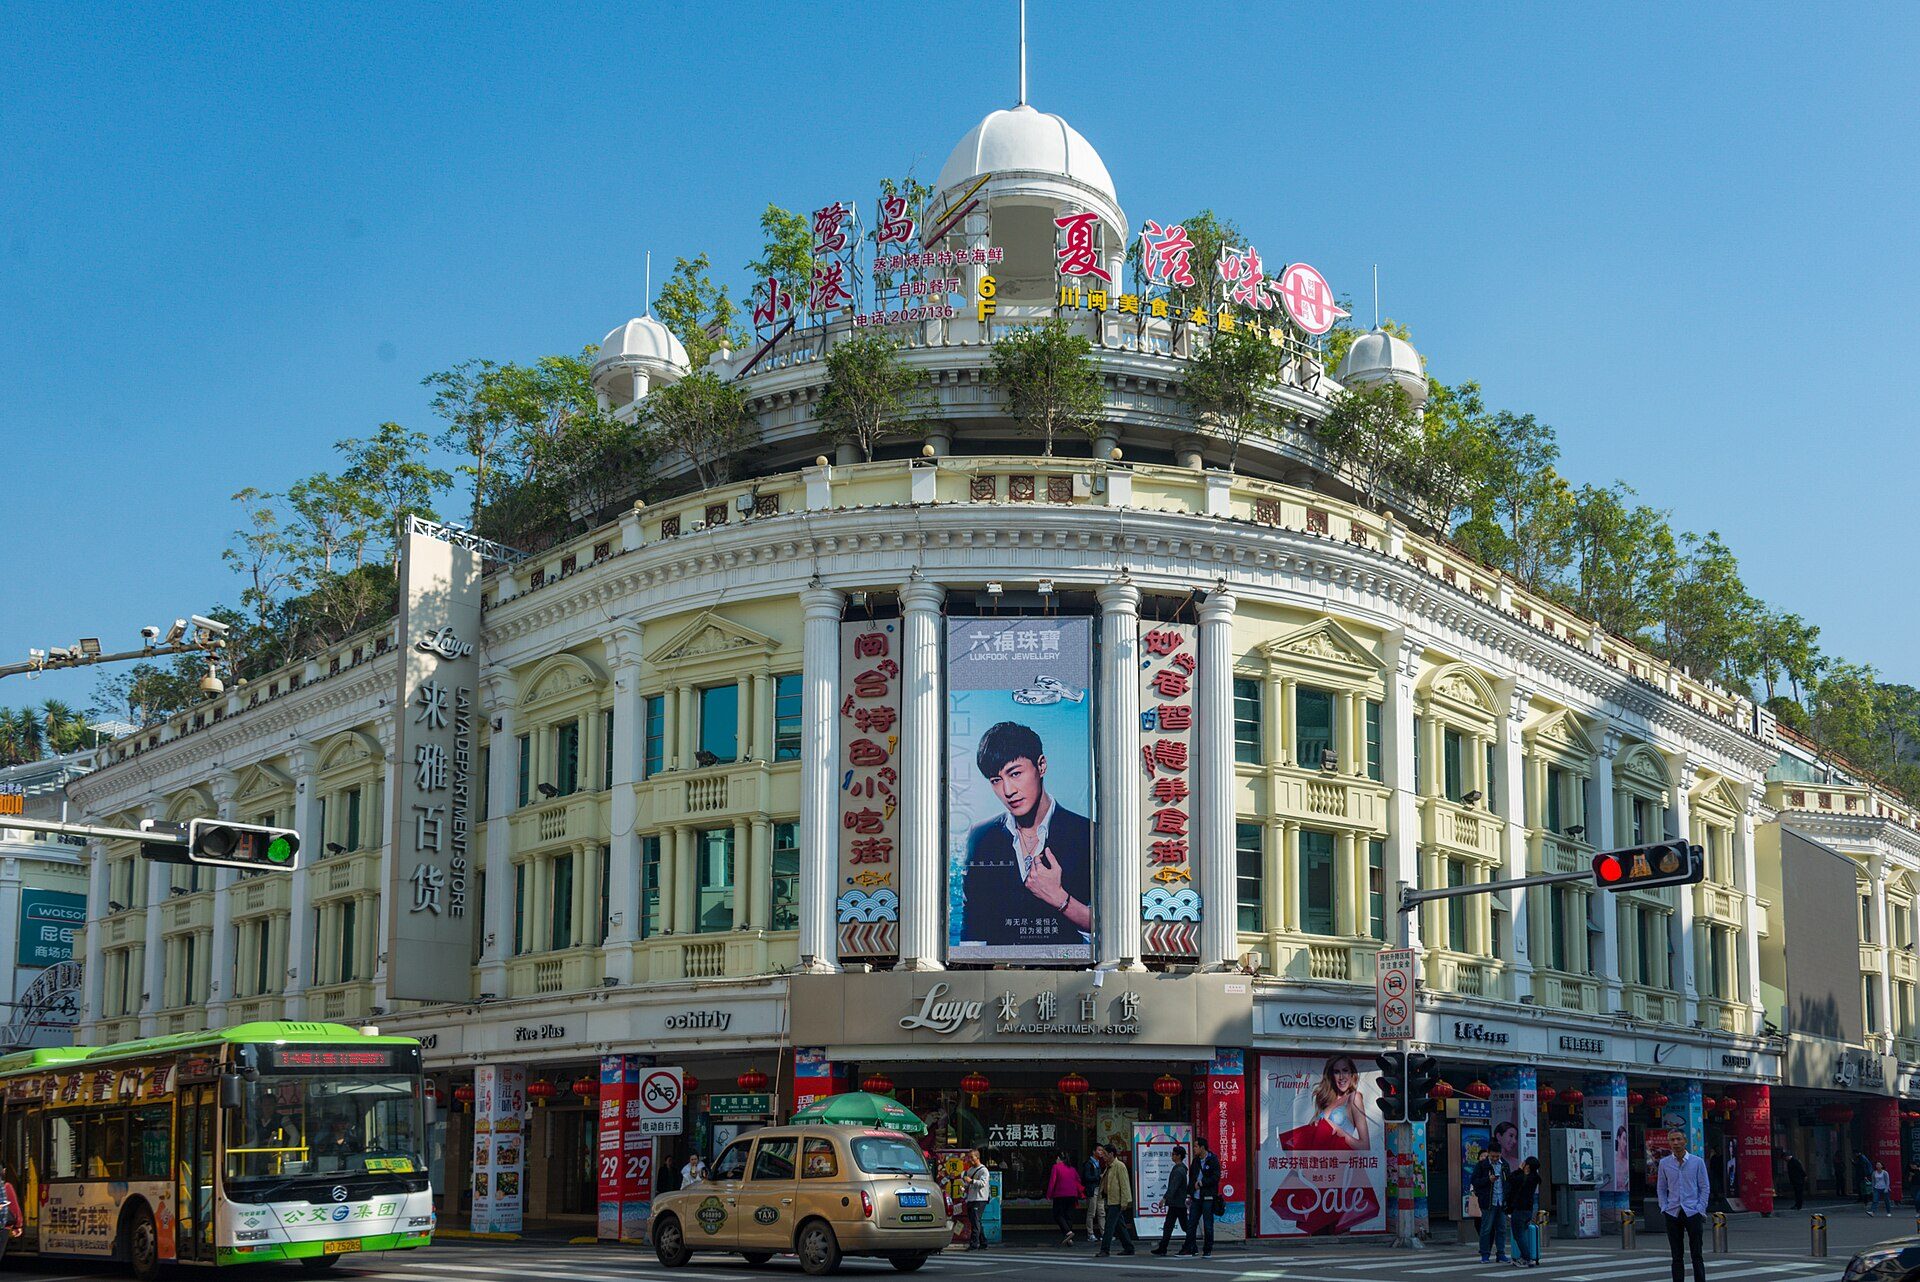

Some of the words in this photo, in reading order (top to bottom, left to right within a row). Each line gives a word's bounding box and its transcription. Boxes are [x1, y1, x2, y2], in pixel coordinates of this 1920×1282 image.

[873, 248, 1003, 272] 蒸涮烤串特色海鲜
[1054, 212, 1273, 311] 夏滋味
[899, 278, 960, 298] 自助餐厅
[415, 626, 473, 660] Laiya
[969, 630, 1060, 652] 六福珠寶
[970, 653, 1009, 661] LUKFOOK
[1012, 652, 1060, 660] JEWELLERY
[410, 680, 450, 916] 来雅百货
[1020, 926, 1059, 934] 因为爱很美
[899, 982, 983, 1034] Laiya
[998, 991, 1141, 1022] 来雅百货
[664, 1010, 730, 1031] ochirly
[996, 1024, 1026, 1034] LAIYA
[1280, 1012, 1356, 1029] watsons
[514, 1027, 538, 1041] Five
[540, 1024, 565, 1038] Plus
[1213, 1081, 1239, 1090] OLGA
[1267, 1073, 1310, 1094] Triumph
[642, 1120, 681, 1132] 电动自行车
[989, 1124, 1056, 1141] 六福珠寶
[601, 1156, 618, 1179] 29
[625, 1156, 651, 1179] 29
[1268, 1156, 1378, 1169] 黛安芬福建省唯一折扣店
[1286, 1166, 1369, 1215] Sale
[283, 1207, 328, 1224] 公交
[353, 1202, 397, 1219] 集团
